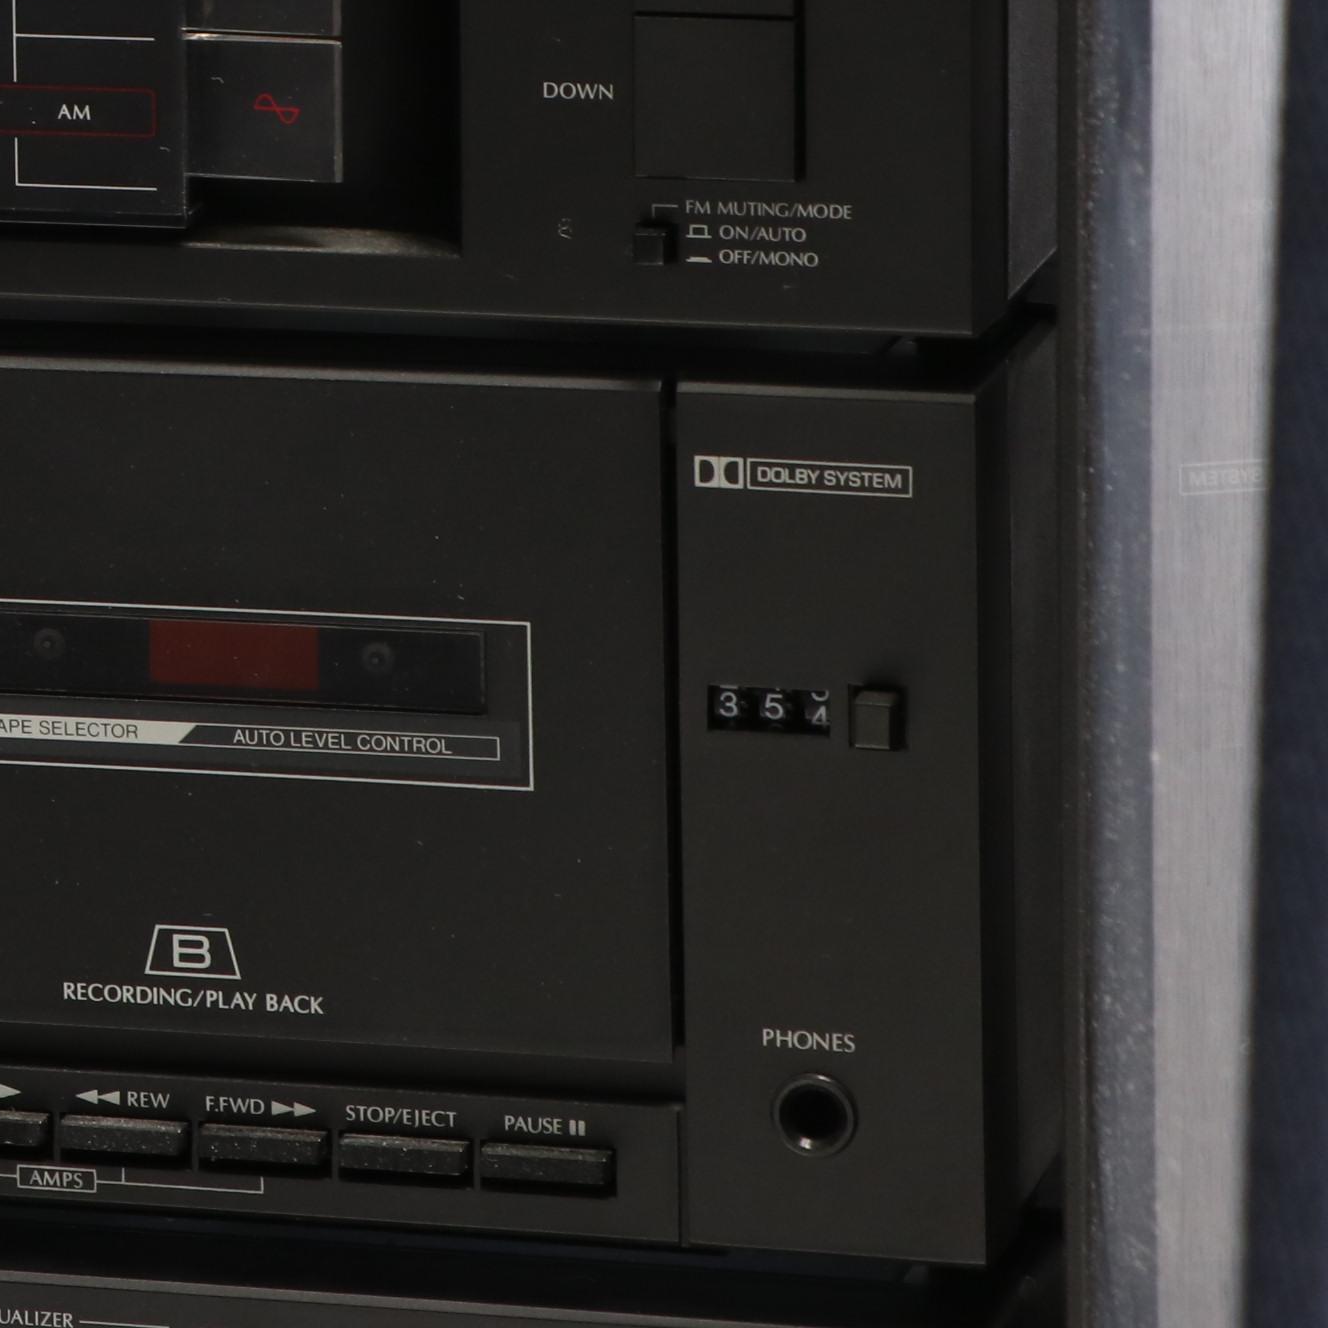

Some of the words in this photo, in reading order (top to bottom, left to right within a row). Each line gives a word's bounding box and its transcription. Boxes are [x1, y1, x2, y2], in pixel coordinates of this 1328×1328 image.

[543, 81, 614, 100] DOWN
[57, 103, 91, 121] AM
[685, 199, 711, 215] FM
[717, 201, 852, 220] MUTING/MODE
[718, 224, 807, 243] ON/AUTO
[718, 249, 819, 268] OFF/MONO
[757, 466, 820, 485] DOLBY
[823, 469, 902, 489] SYSTEM
[39, 720, 138, 739] SELECTOR
[233, 729, 285, 746] AUTO
[290, 731, 352, 750] LEVEL
[355, 729, 453, 756] CONTROL
[172, 933, 212, 969] B
[63, 981, 257, 1011] RECORDING/PLAY
[265, 993, 324, 1015] BACK
[762, 1028, 856, 1053] PHONES
[127, 1090, 170, 1109] REW
[205, 1095, 265, 1115] F.FWD
[345, 1104, 457, 1128] STOP/EJECT
[504, 1114, 563, 1135] PAUSE
[27, 1169, 84, 1191] AMPS
